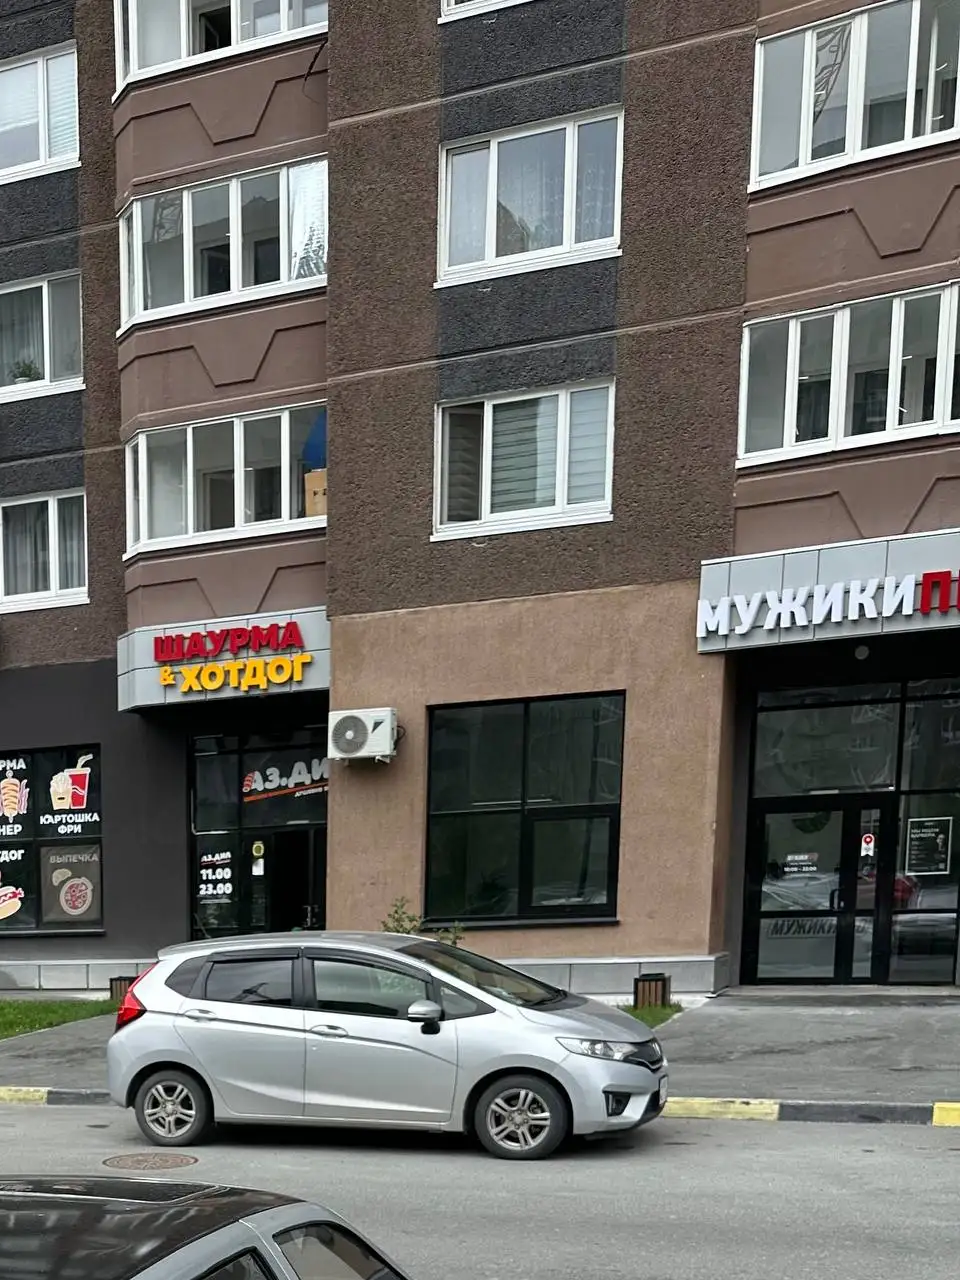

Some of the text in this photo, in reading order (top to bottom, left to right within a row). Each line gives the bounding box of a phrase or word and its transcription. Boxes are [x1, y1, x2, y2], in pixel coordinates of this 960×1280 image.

[154, 621, 305, 662] ШАУРМА
[159, 653, 313, 693] & ХОТДОГ
[40, 812, 100, 824] КАРТОШКА
[57, 824, 82, 834] ФРИ
[49, 853, 99, 864] ВЫПЕЧКА
[200, 867, 232, 880] 11.00
[199, 882, 233, 895] 23.00
